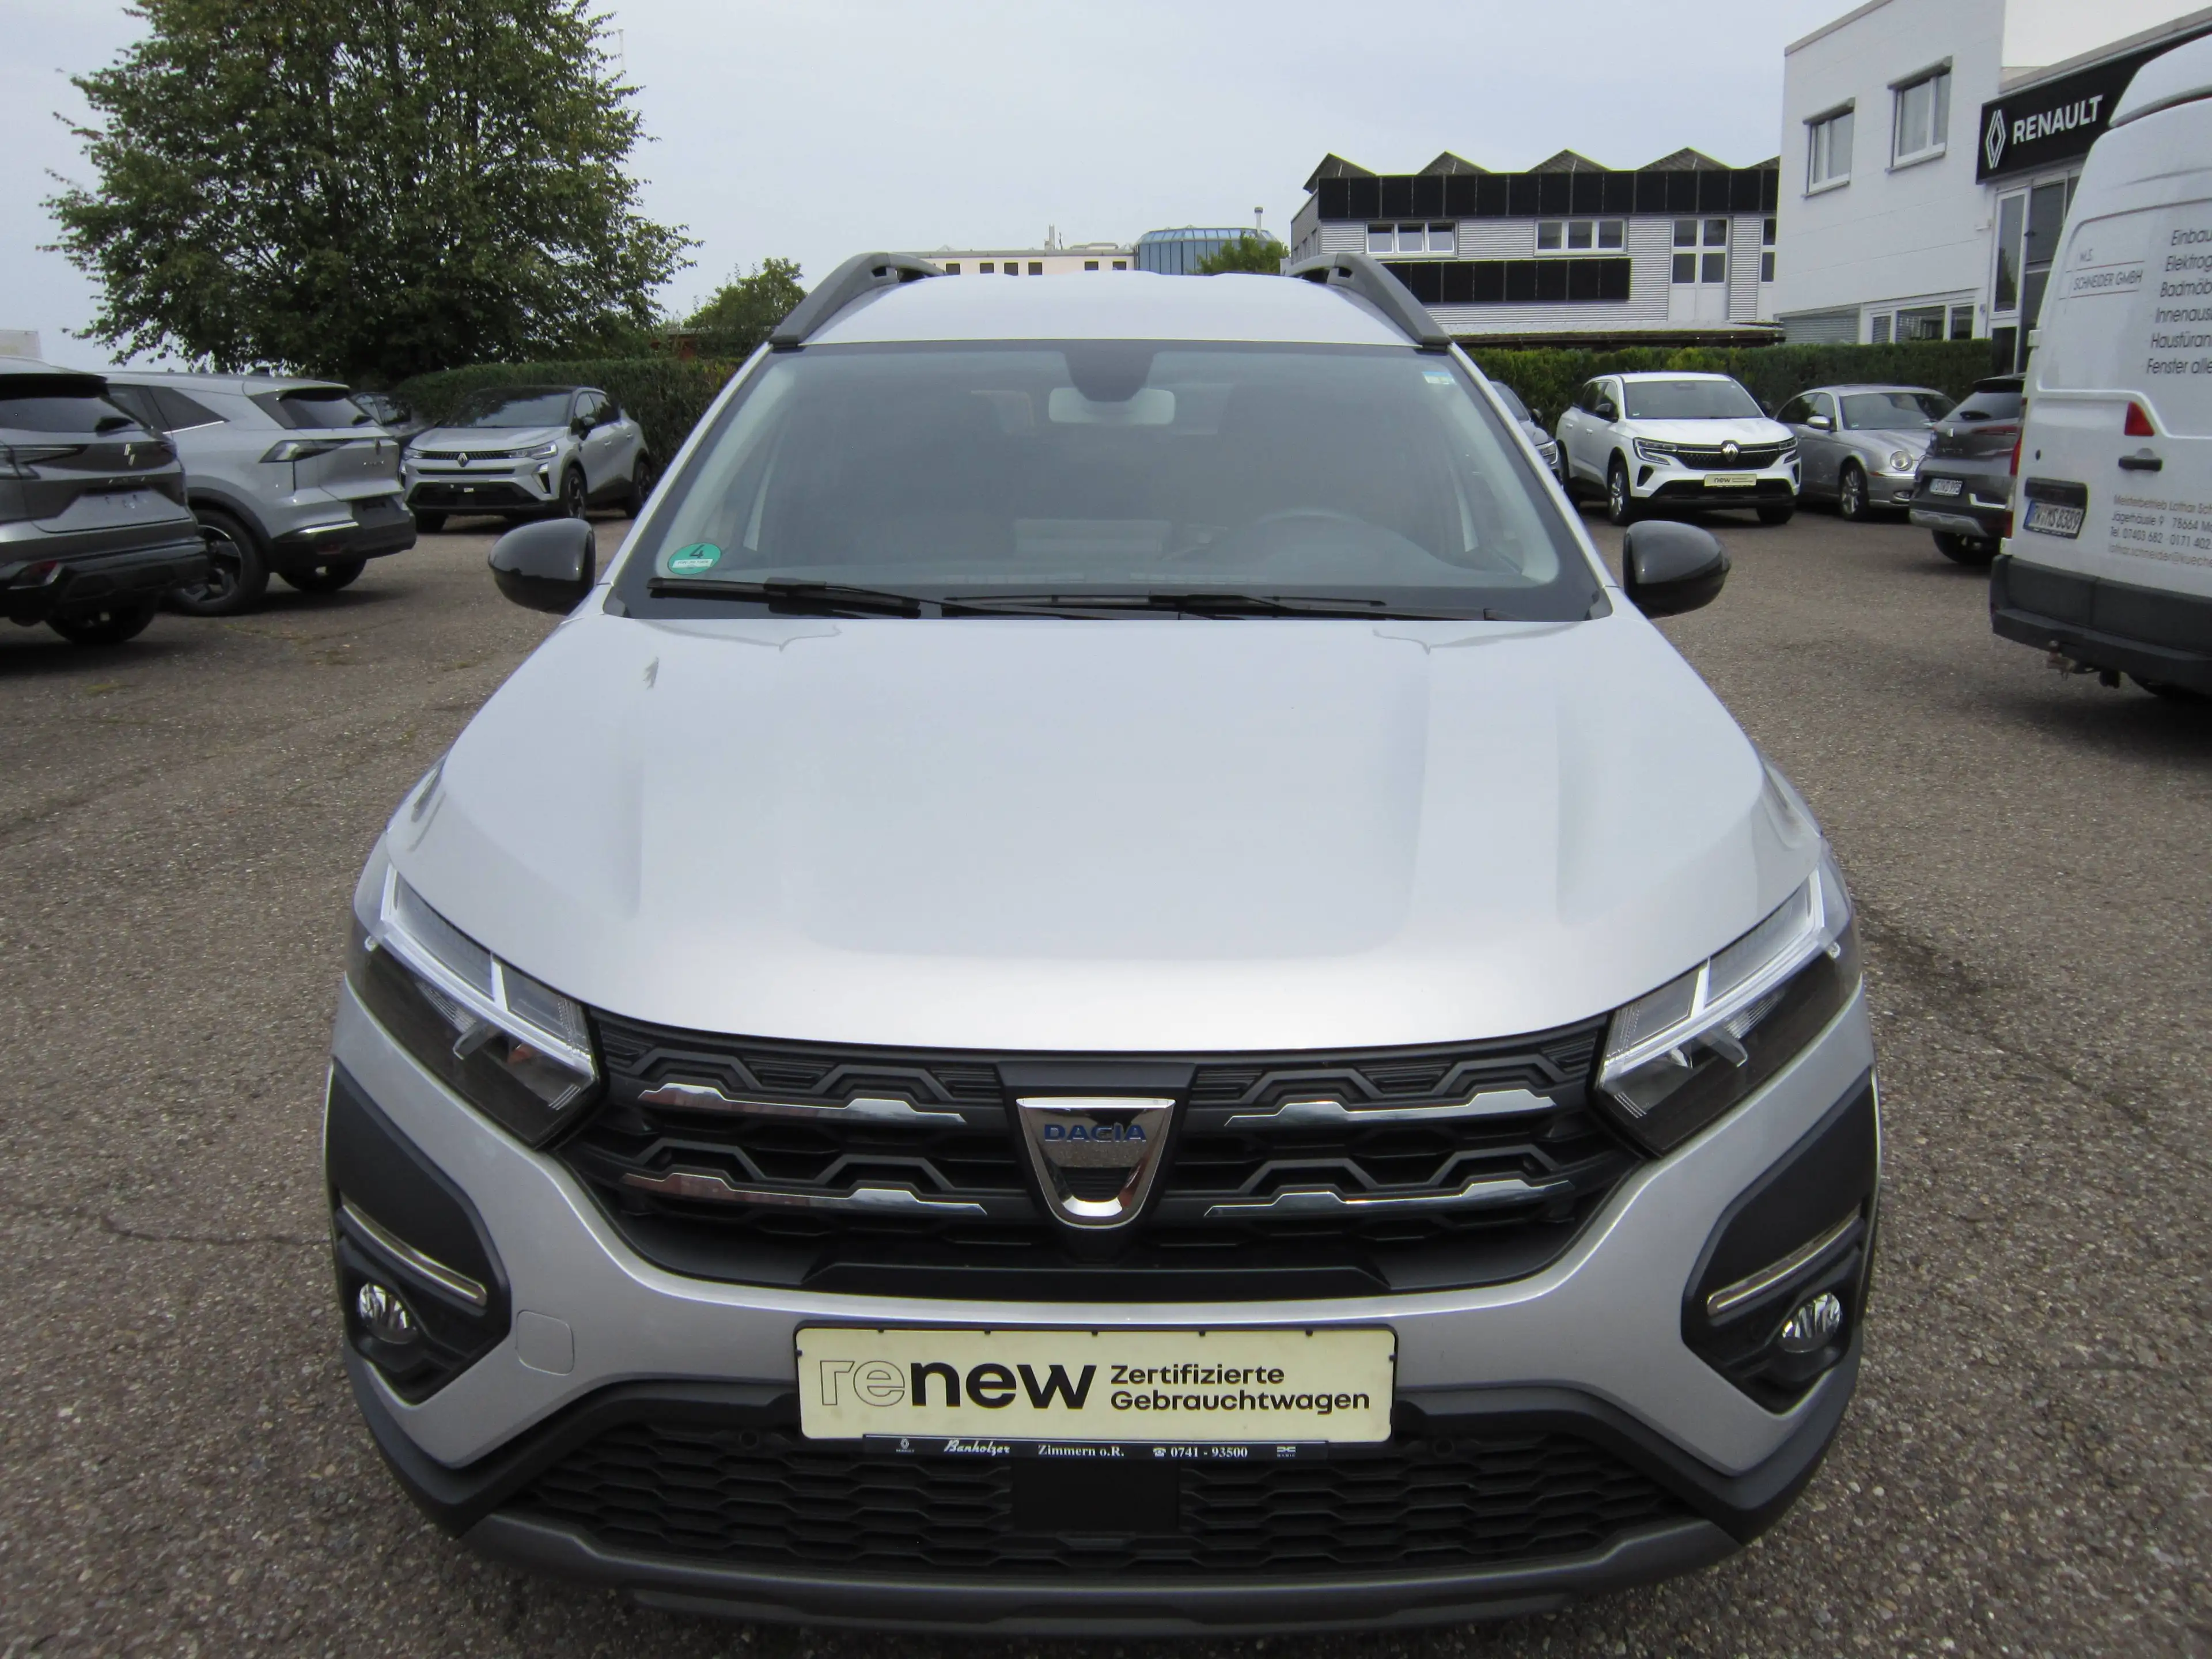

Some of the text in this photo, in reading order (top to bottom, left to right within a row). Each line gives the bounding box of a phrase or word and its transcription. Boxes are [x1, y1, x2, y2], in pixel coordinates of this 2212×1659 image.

[2013, 94, 2104, 145] RENAULT
[2146, 358, 2188, 374] Fenster
[689, 544, 705, 559] 4
[1044, 1123, 1146, 1142] DACIA
[1111, 1363, 1285, 1384] Zertifizierte
[820, 1360, 1097, 1409] renew
[1111, 1389, 1370, 1415] Gebrauchtwagen
[944, 1440, 1010, 1456] Banholzer
[1039, 1445, 1096, 1456] Zimmern
[1099, 1446, 1124, 1457] o.R.
[1170, 1446, 1199, 1457] 0741
[1211, 1446, 1248, 1458] 93500
